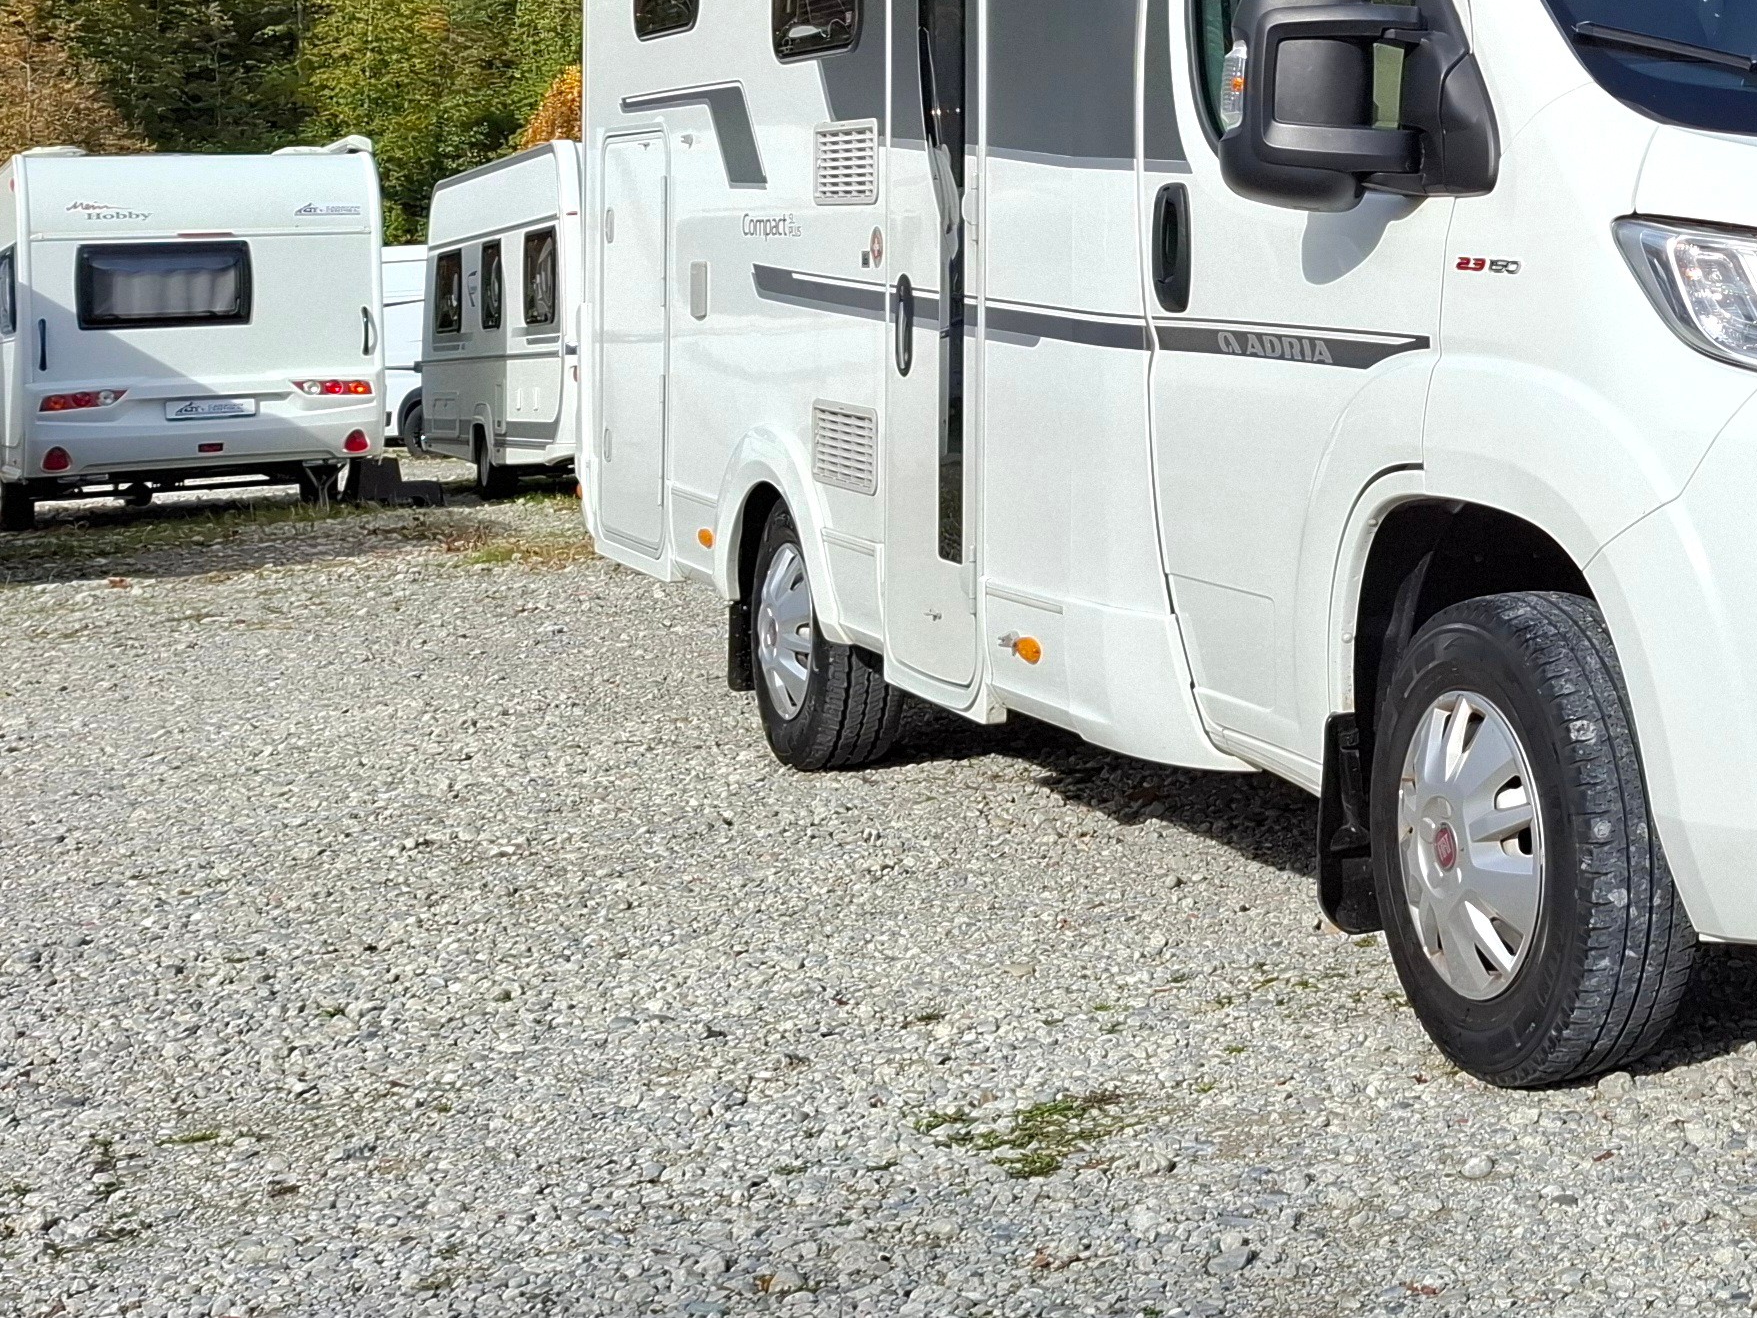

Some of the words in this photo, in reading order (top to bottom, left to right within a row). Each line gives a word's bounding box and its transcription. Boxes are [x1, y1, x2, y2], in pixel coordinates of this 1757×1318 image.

[86, 211, 154, 221] Hobby
[742, 213, 787, 242] Compact
[1246, 333, 1333, 364] ADRIA
